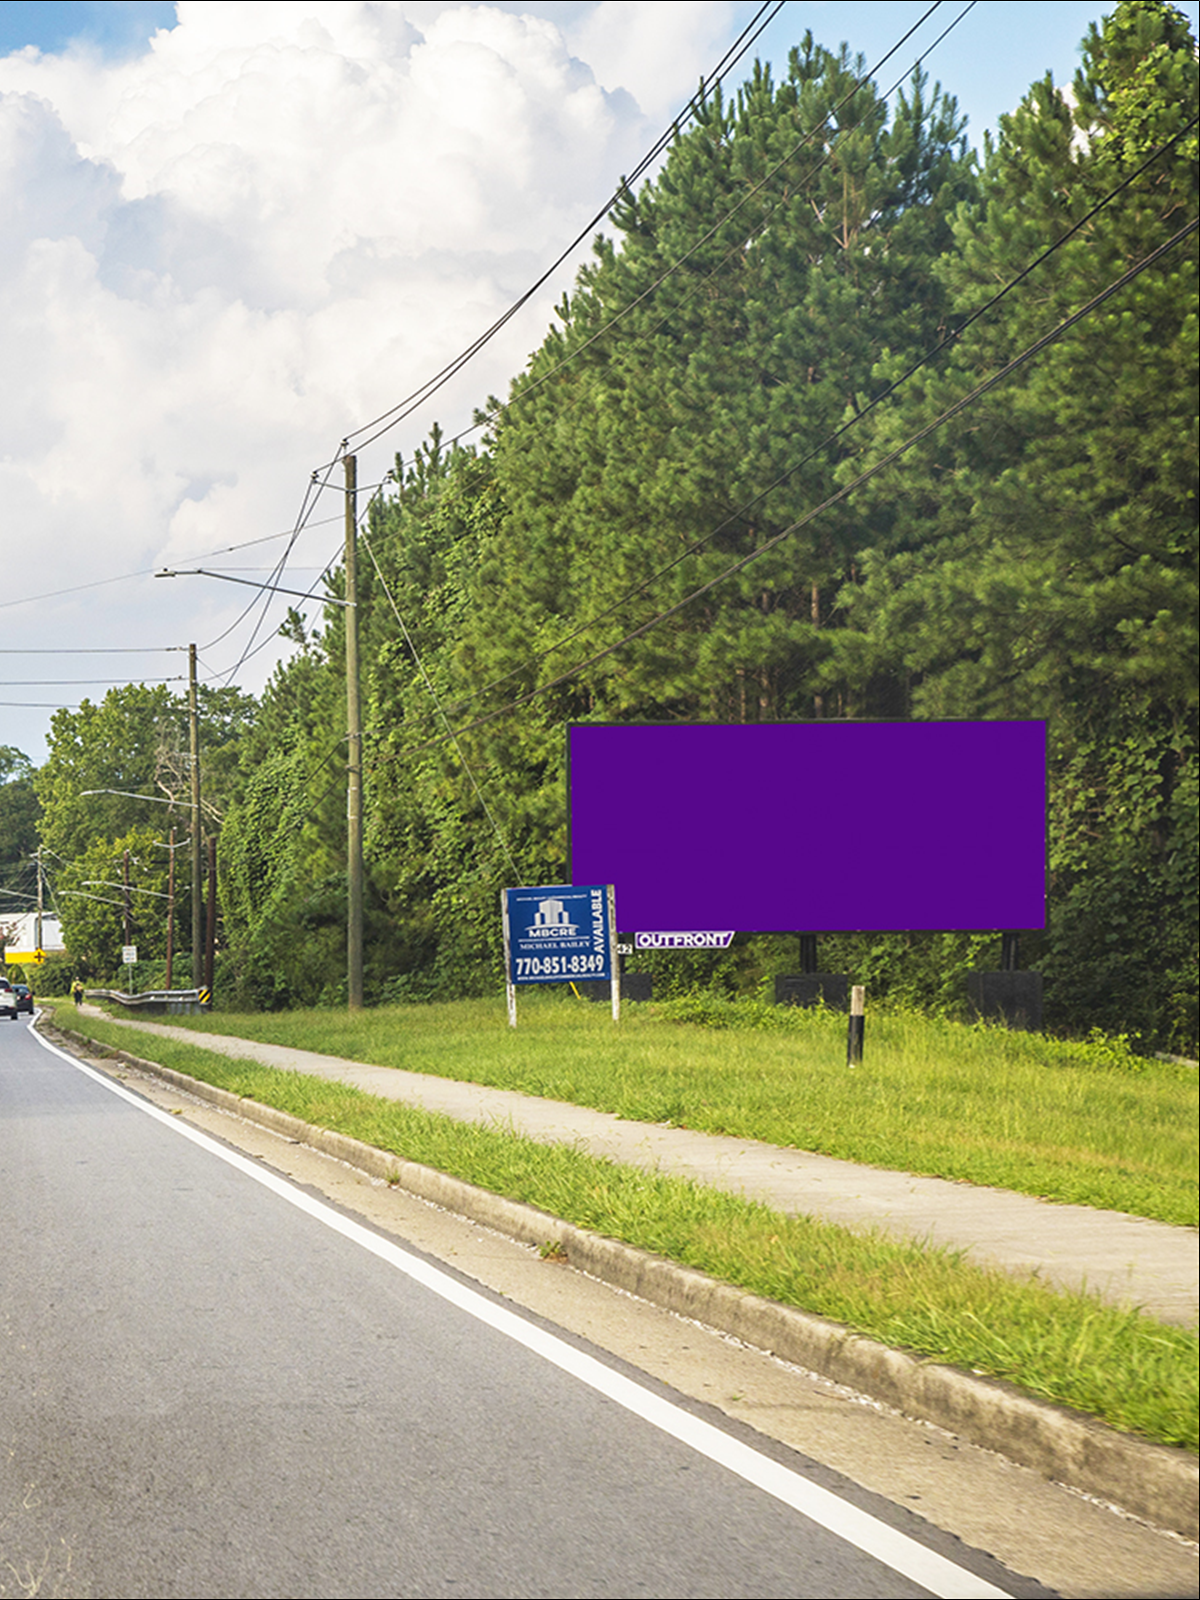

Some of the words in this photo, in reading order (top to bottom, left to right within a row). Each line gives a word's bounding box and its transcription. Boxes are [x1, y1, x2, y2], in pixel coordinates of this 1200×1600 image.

[591, 889, 605, 954] AVAILABLE
[528, 927, 577, 938] MBCRE
[639, 932, 728, 947] OUTFRONT
[520, 942, 559, 950] MICHAEL
[560, 940, 591, 949] BAILEY
[515, 954, 605, 975] 770-851-8349
